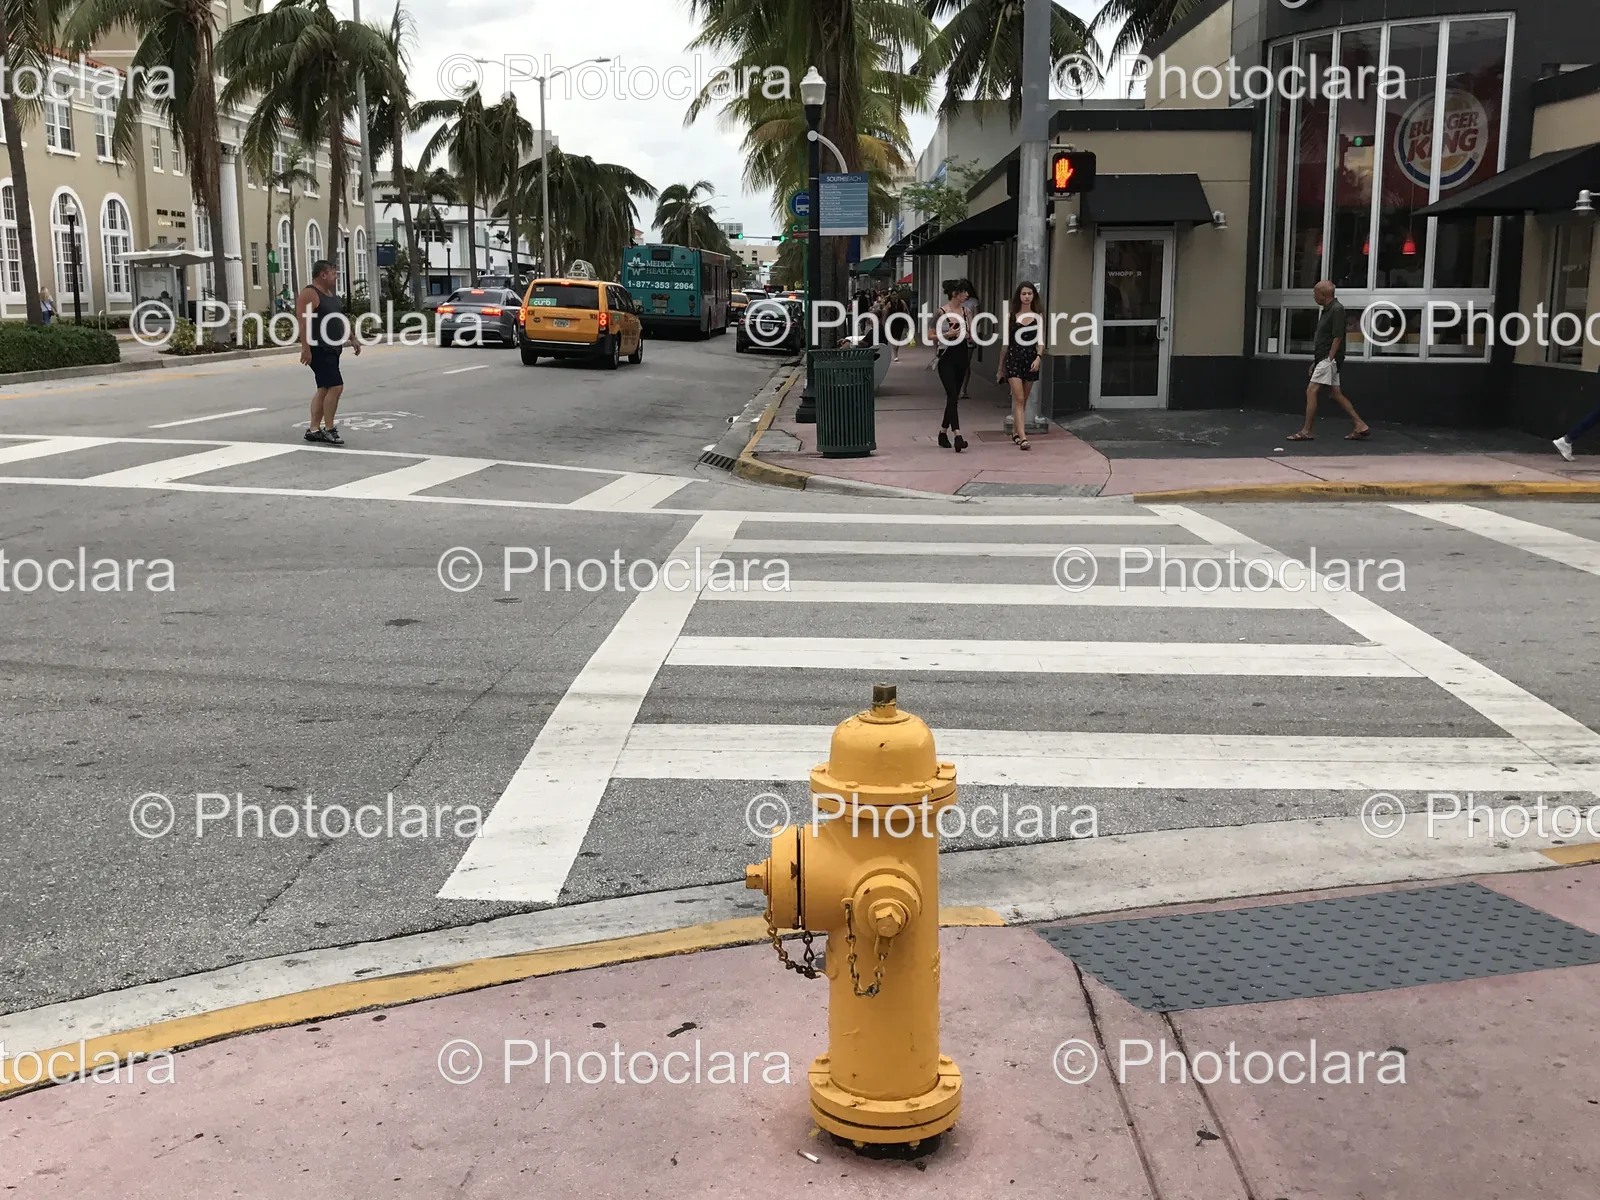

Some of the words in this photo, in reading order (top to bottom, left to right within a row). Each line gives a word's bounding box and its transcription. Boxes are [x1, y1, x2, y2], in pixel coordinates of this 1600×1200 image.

[1409, 112, 1479, 139] BUGER
[1407, 128, 1479, 163] KNG
[646, 260, 675, 268] MEDICA
